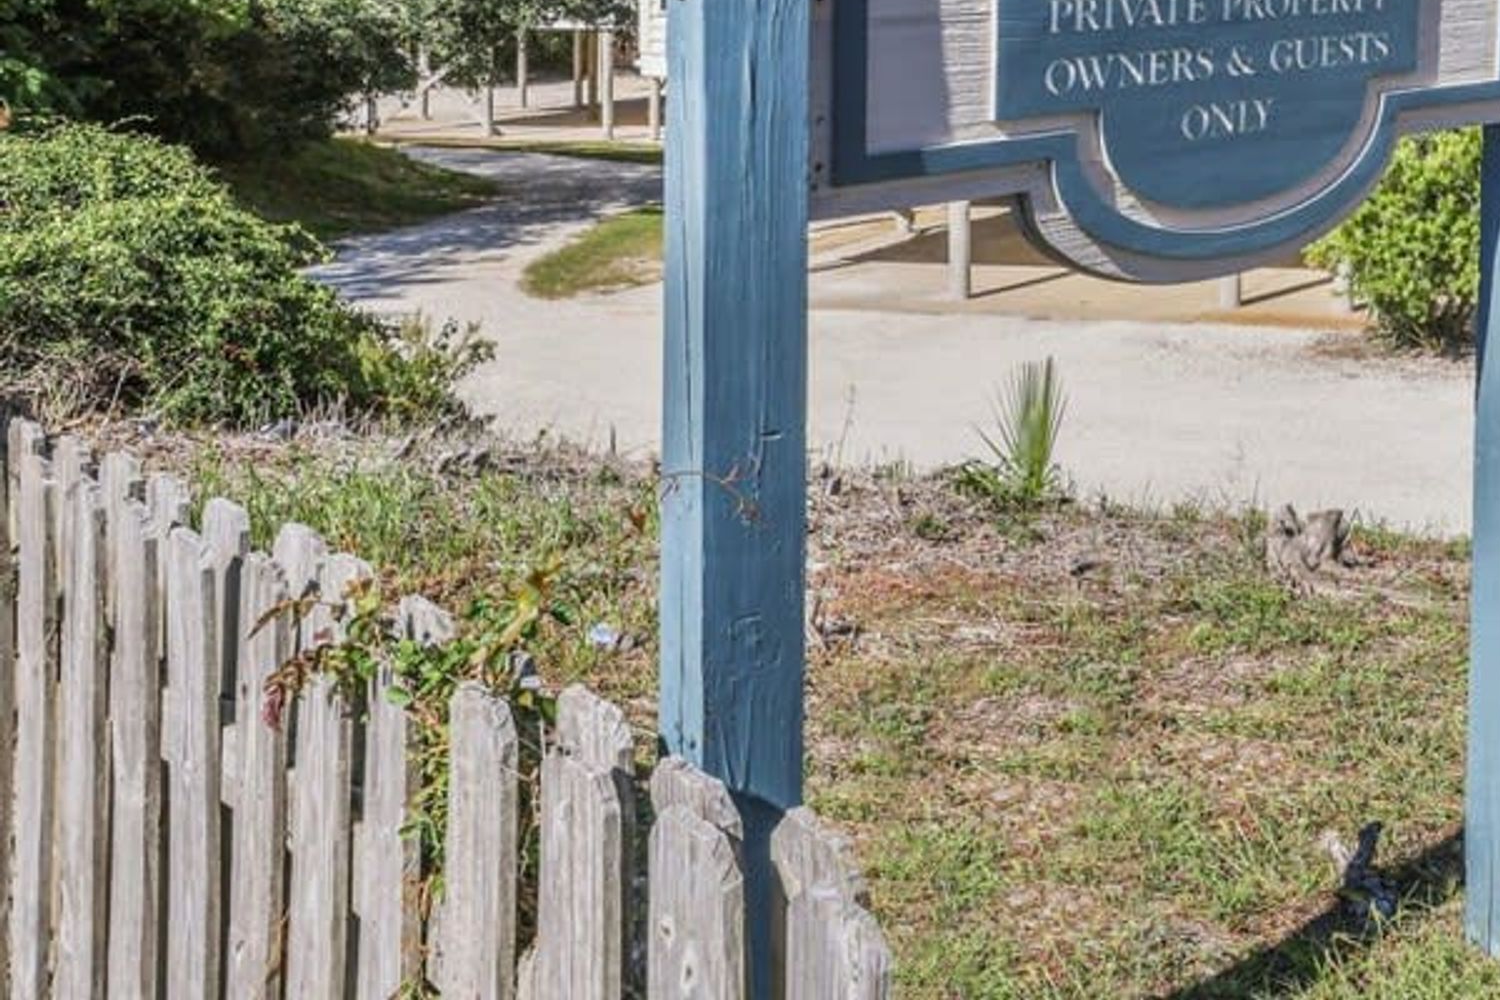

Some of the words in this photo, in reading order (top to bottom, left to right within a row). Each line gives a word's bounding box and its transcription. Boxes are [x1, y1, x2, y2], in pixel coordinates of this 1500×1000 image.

[1044, 46, 1214, 96] OWNERS
[1227, 47, 1256, 77] &
[1269, 31, 1390, 73] GUESTS
[1180, 99, 1275, 141] ONLY
